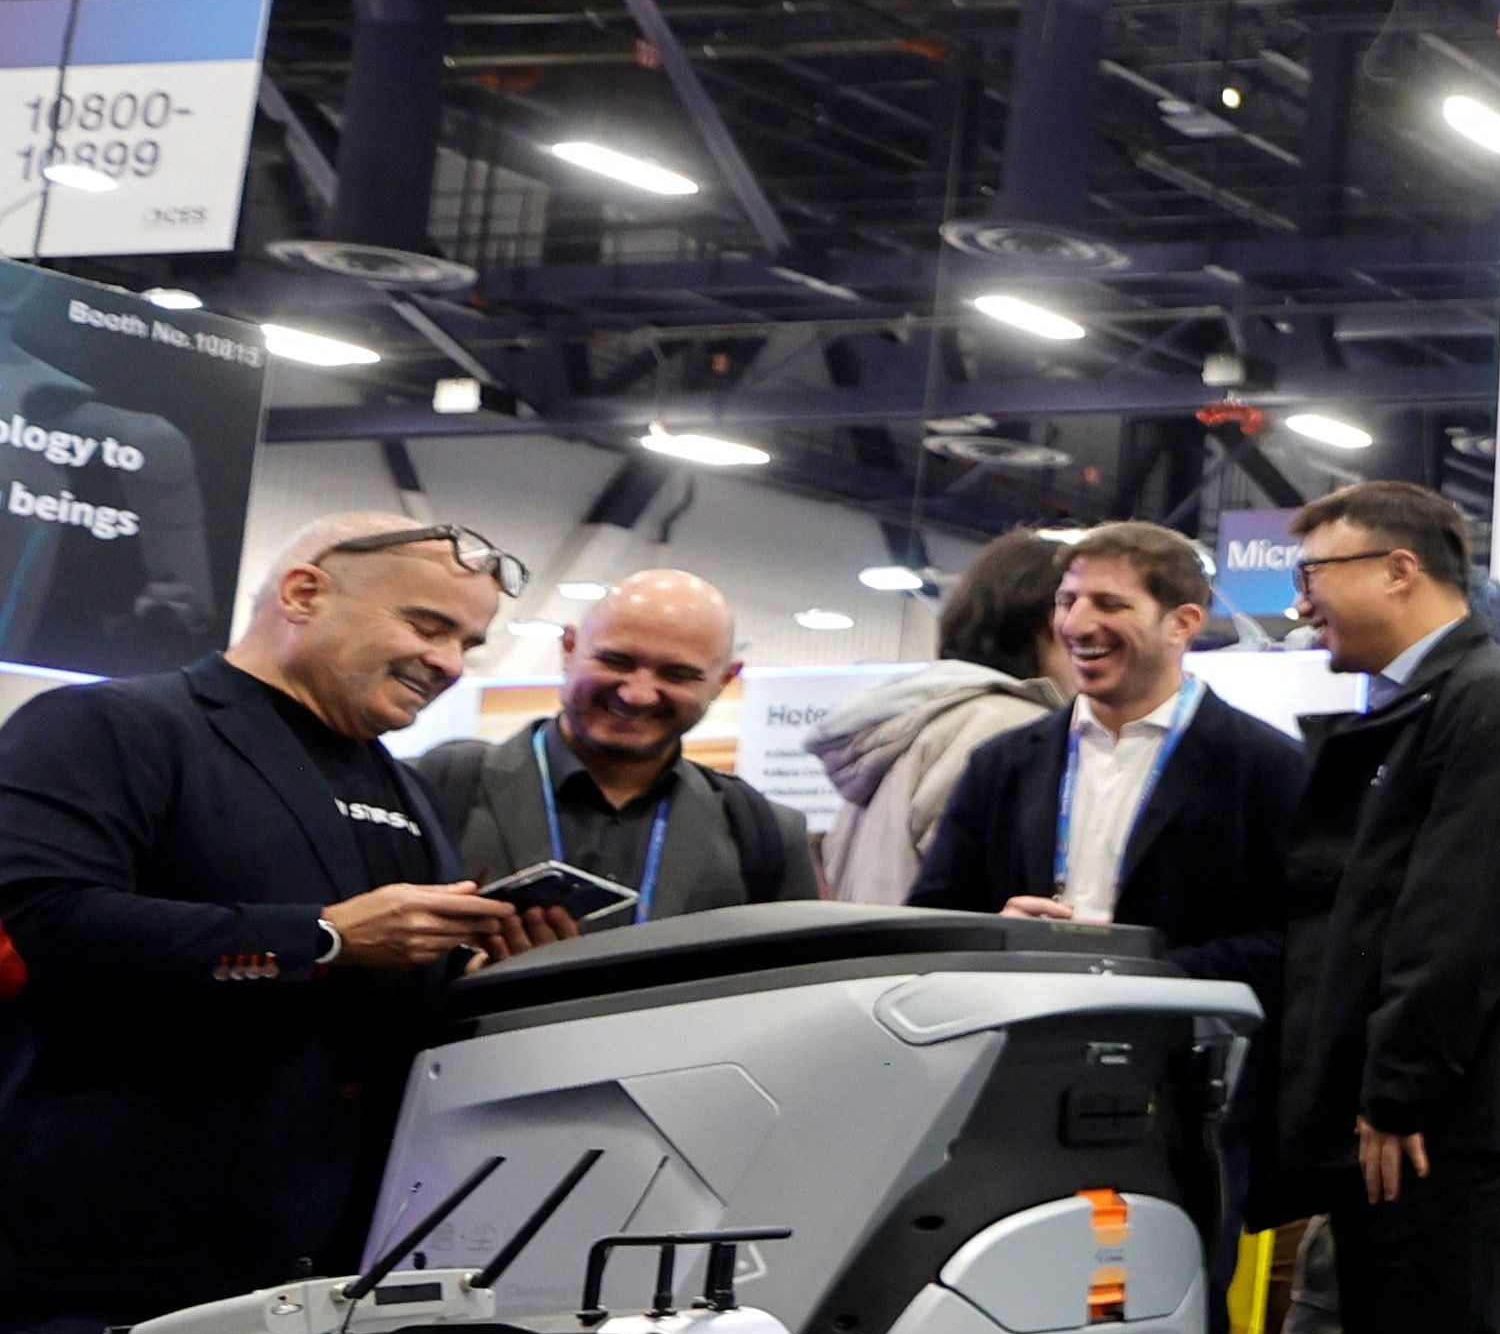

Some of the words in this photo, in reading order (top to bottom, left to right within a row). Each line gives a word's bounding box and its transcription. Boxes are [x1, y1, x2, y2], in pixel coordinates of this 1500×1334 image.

[69, 300, 150, 339] Booth
[101, 436, 146, 472] to
[8, 480, 141, 540] beings
